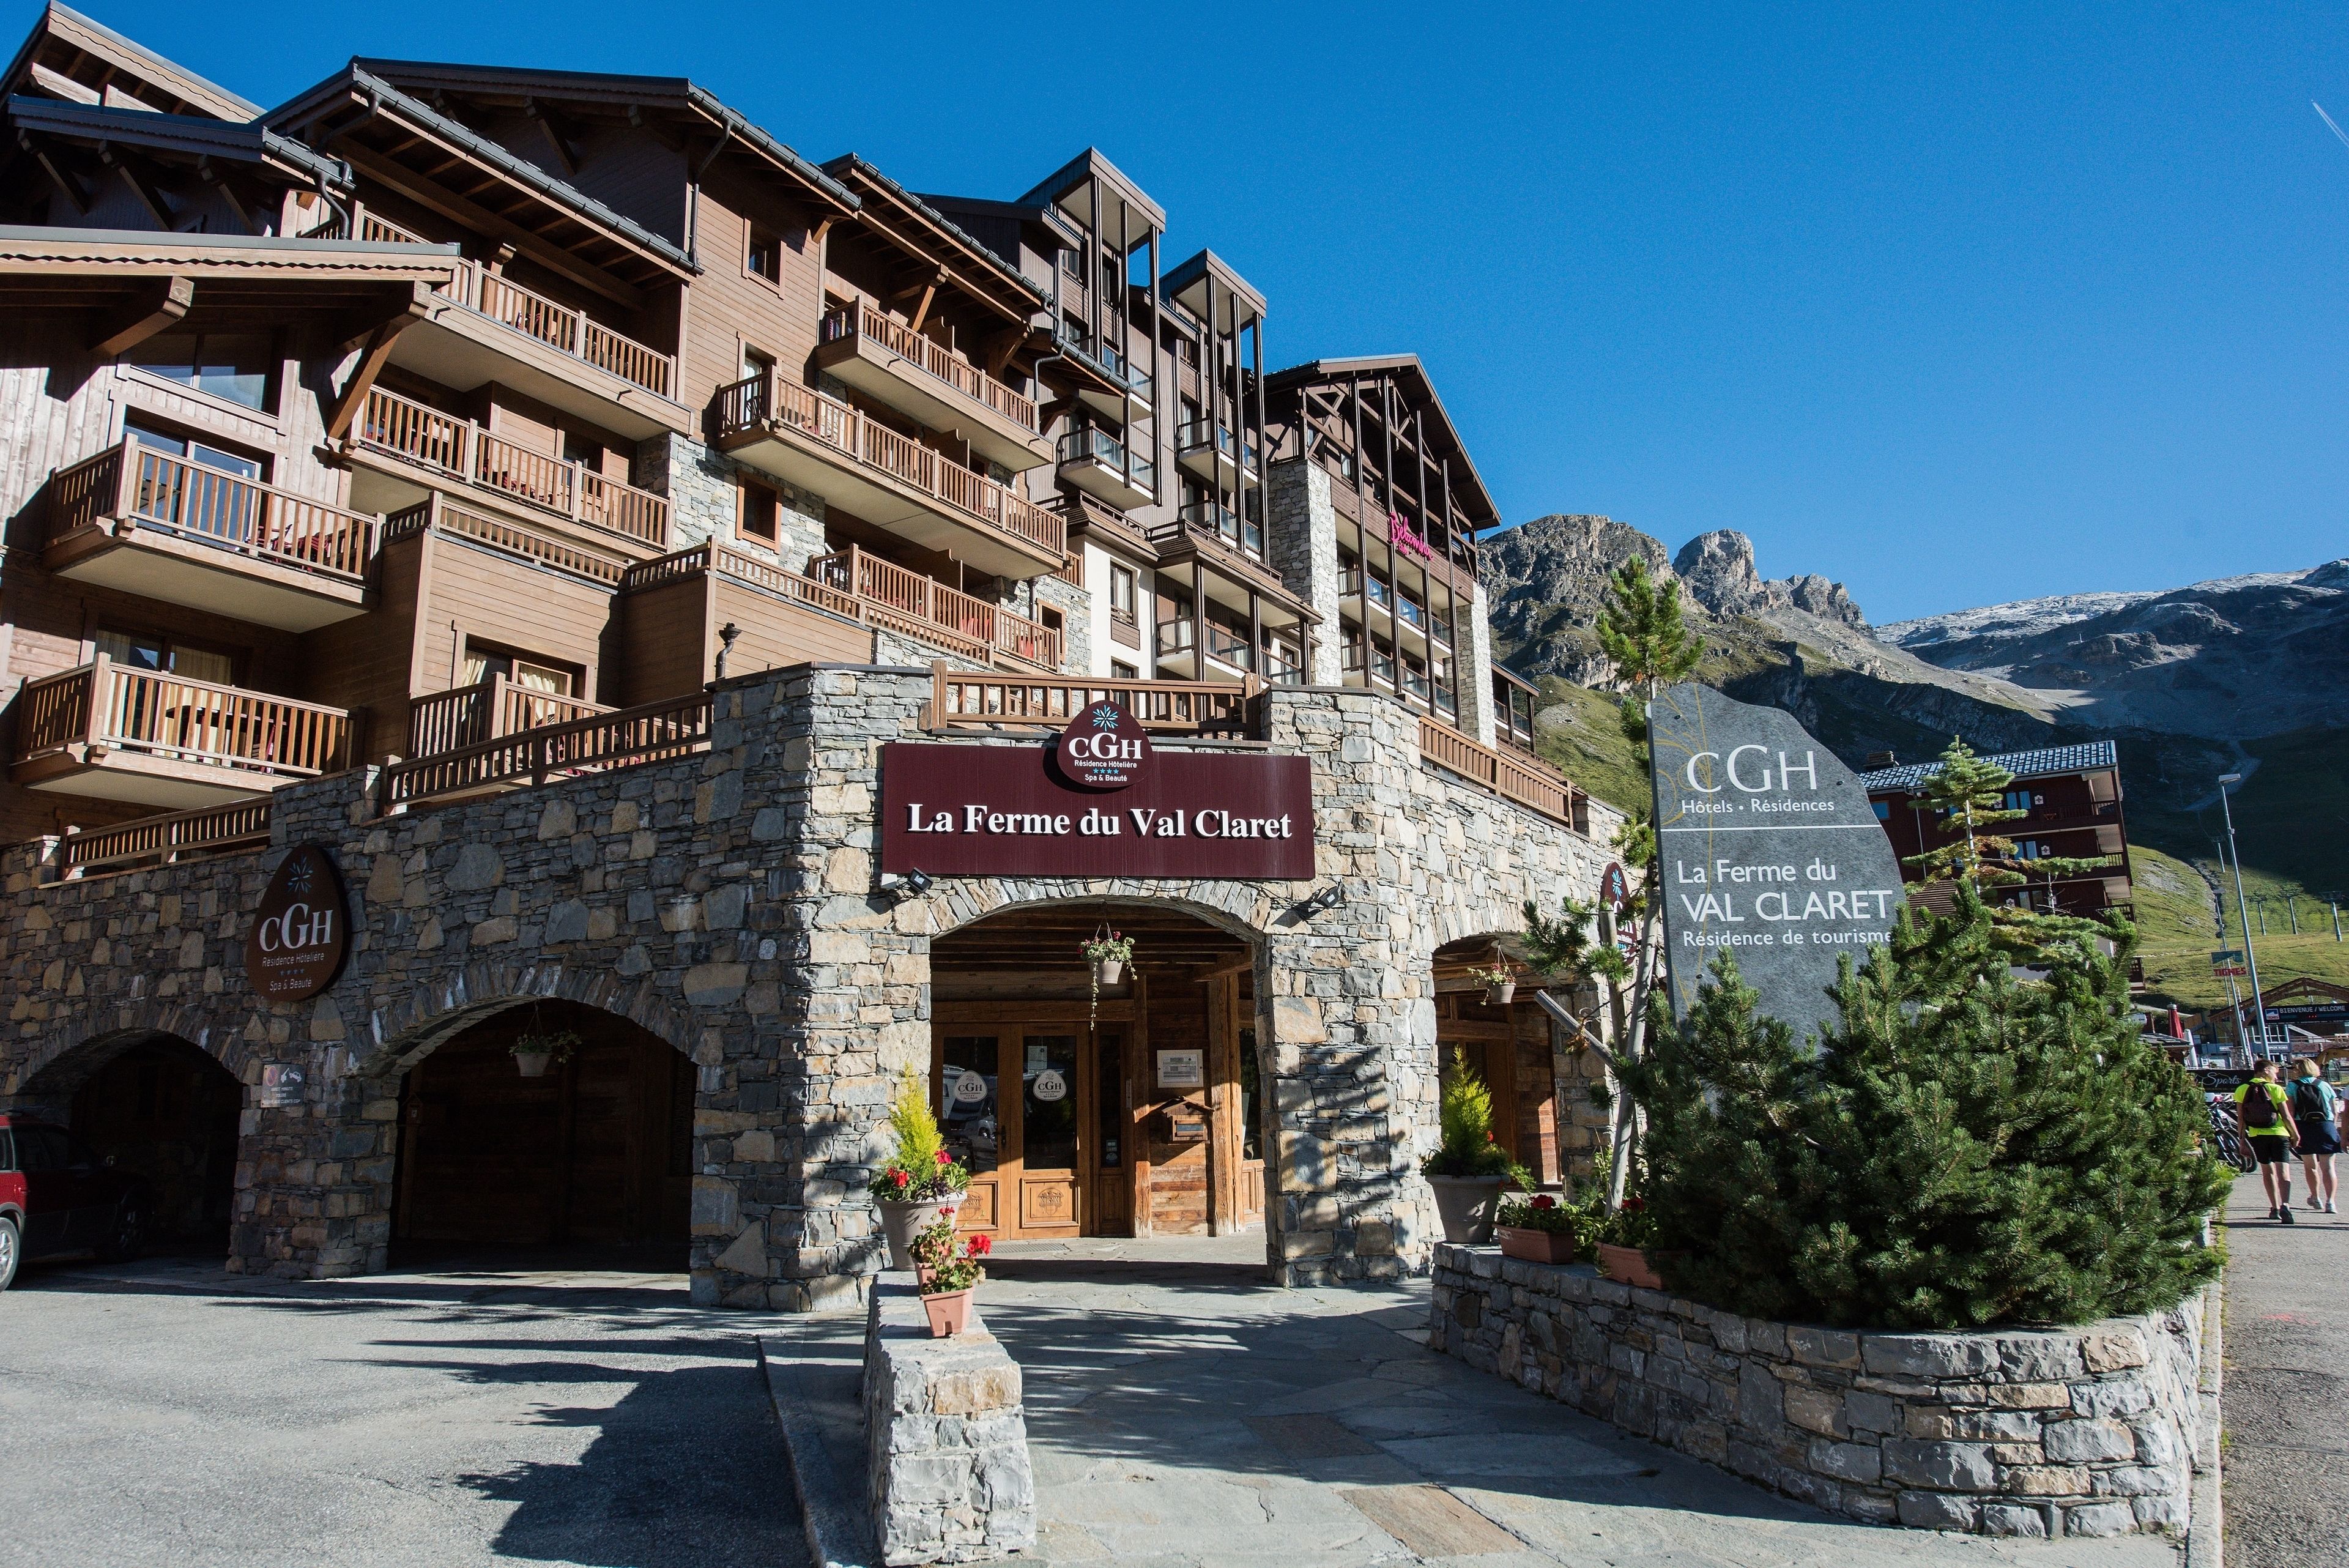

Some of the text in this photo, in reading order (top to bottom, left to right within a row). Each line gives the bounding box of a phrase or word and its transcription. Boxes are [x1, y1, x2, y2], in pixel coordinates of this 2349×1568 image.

[1069, 732, 1143, 759] CGH
[1687, 744, 1817, 793] CGH
[1085, 774, 1097, 782] Spa
[1681, 798, 1835, 814] Hôtels Résidences
[908, 803, 1293, 838] La Ferme du Val Claret
[1677, 858, 1836, 883] La Ferme du
[1680, 890, 1893, 923] VAL CLARET
[259, 902, 333, 952] CGH
[1683, 929, 1892, 946] Résidence de tourisme
[2213, 968, 2246, 976] TIGNES
[269, 981, 281, 993] Spa
[289, 977, 312, 989] Beauté
[958, 1082, 982, 1092] CGH
[1038, 1081, 1061, 1090] CGH
[2202, 1072, 2242, 1088] Sports
